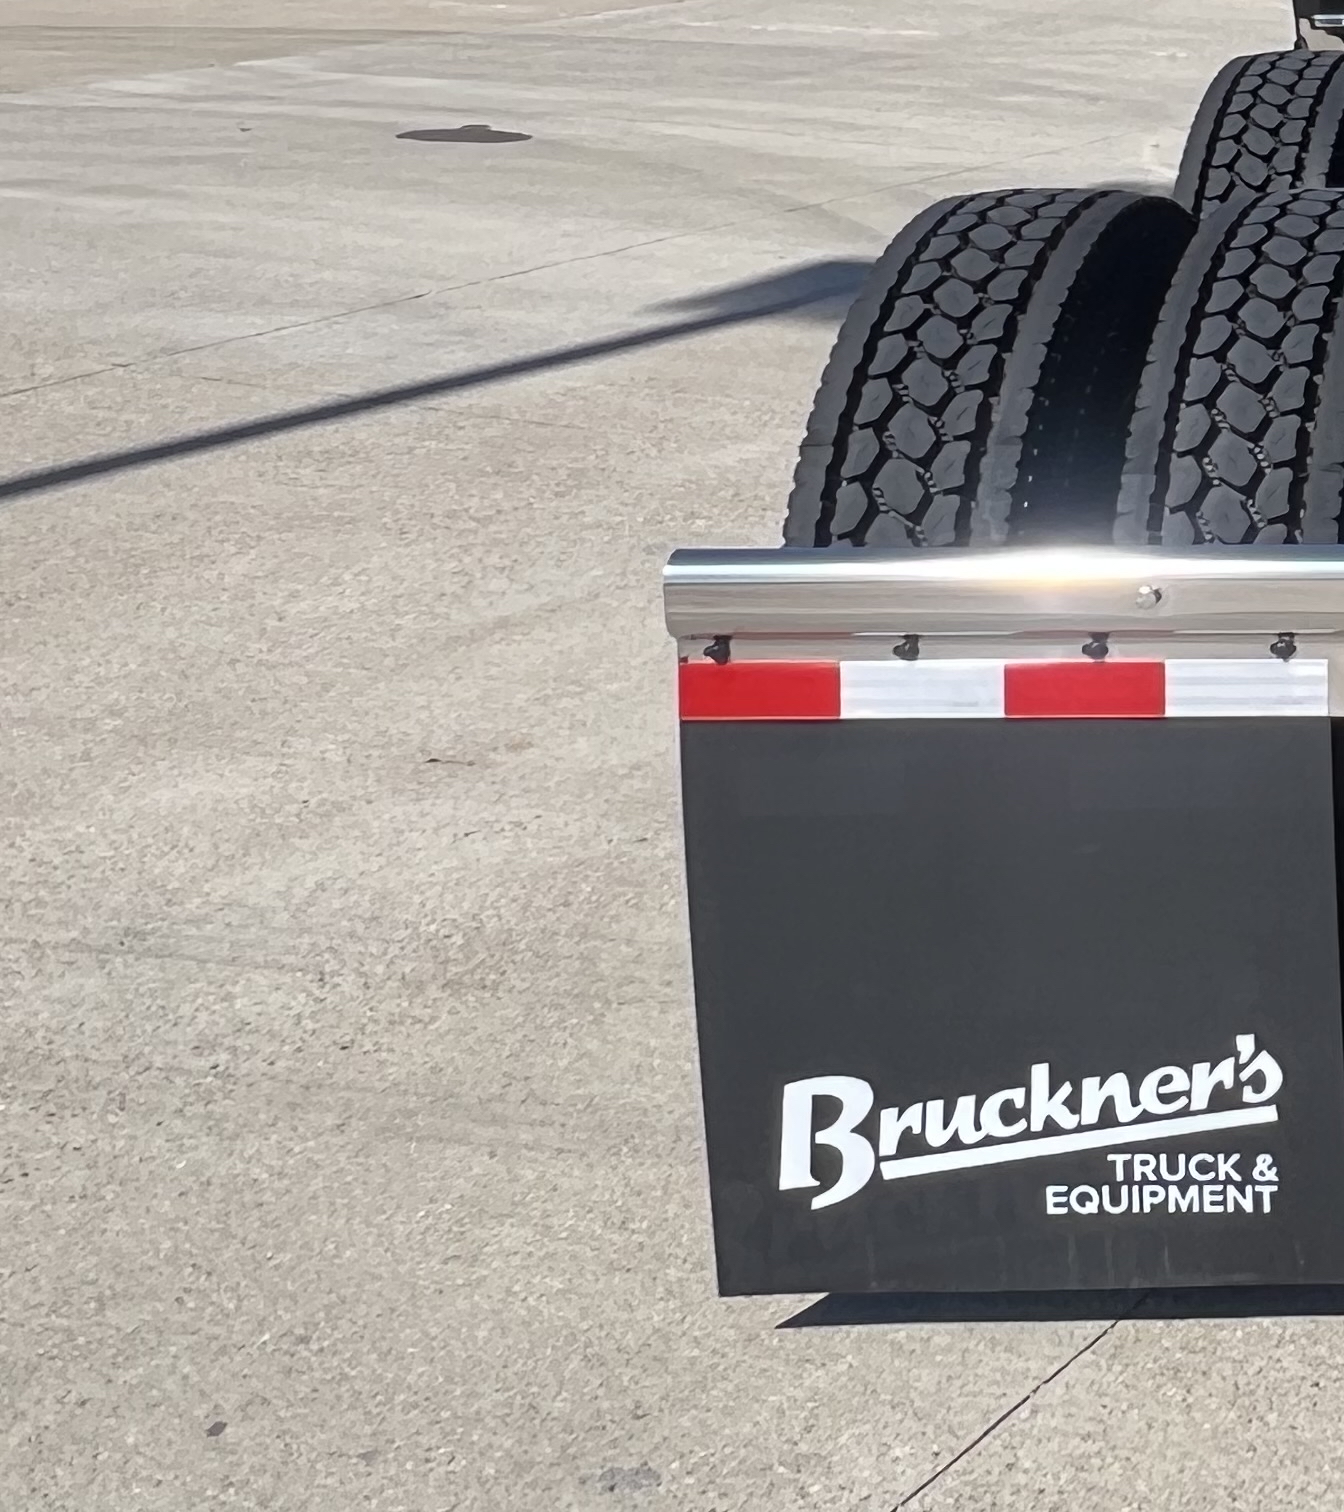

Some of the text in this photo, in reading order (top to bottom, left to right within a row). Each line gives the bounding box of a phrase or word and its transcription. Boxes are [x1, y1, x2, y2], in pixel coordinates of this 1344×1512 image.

[778, 1033, 1284, 1211] Bruckner's
[1106, 1152, 1280, 1182] TRUCK &
[1045, 1184, 1279, 1215] EQUIPMENT
